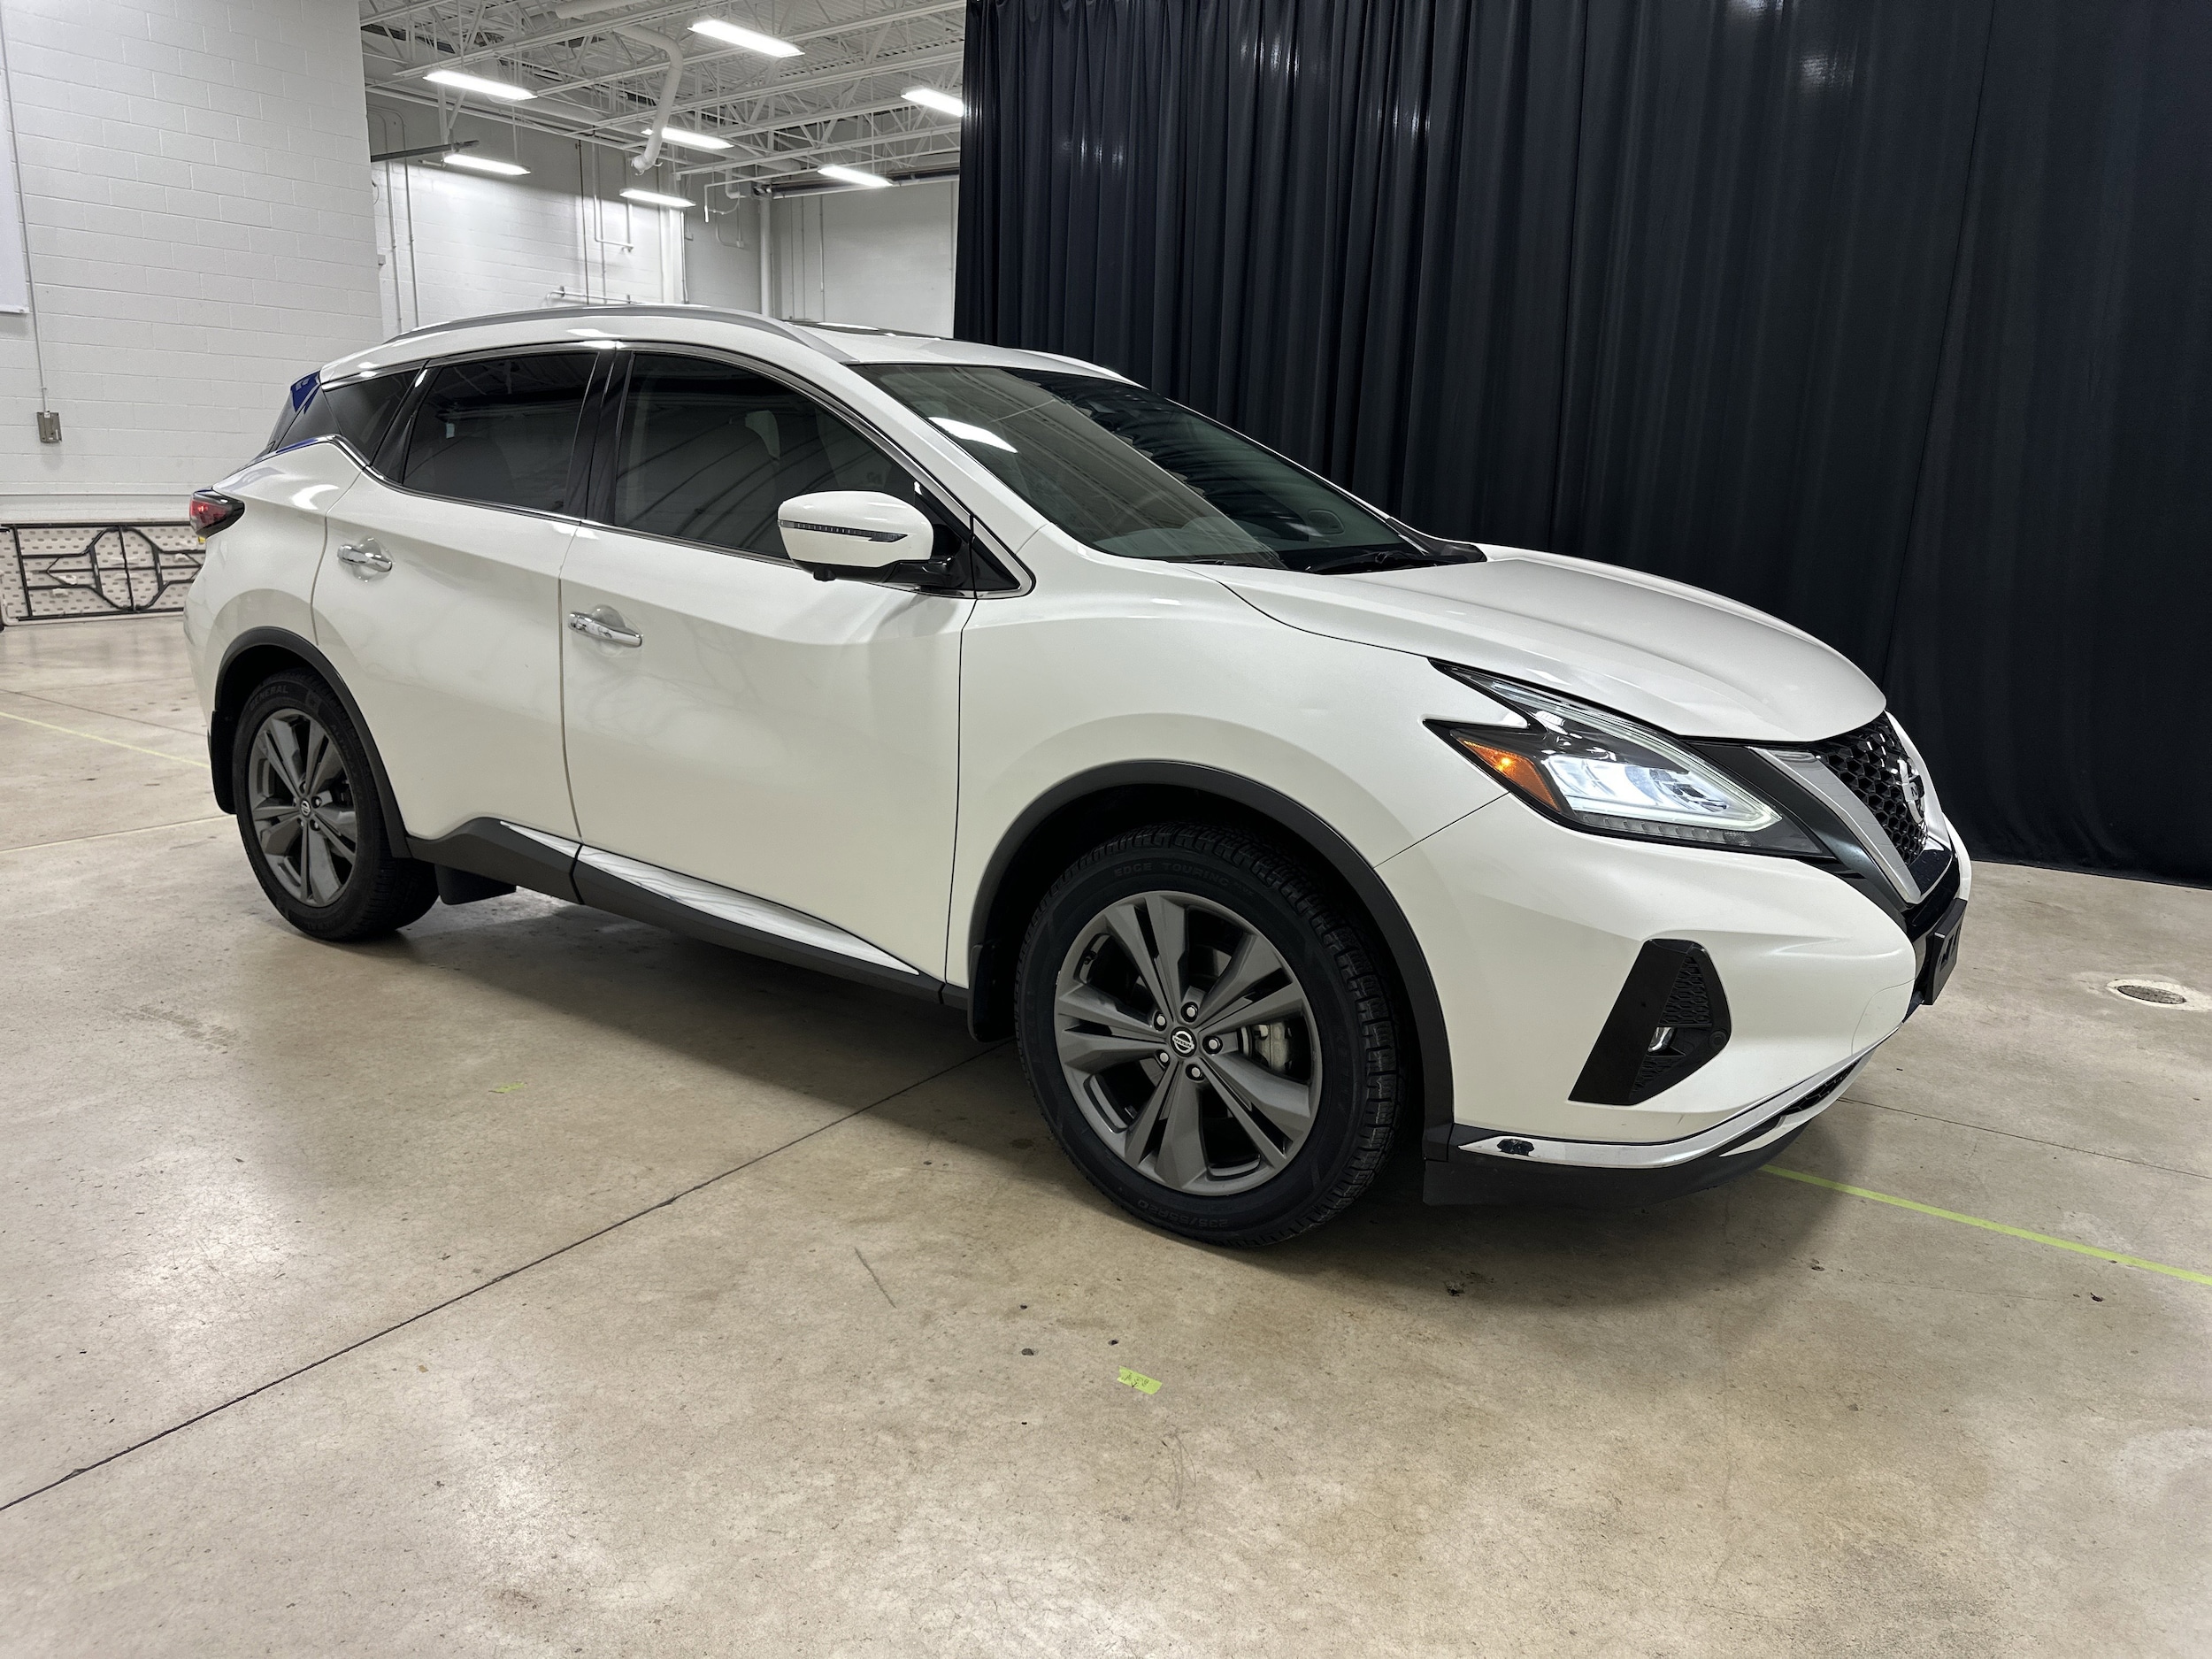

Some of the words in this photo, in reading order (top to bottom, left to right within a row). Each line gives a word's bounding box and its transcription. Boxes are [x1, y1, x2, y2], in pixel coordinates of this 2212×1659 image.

[250, 685, 289, 710] GENERAL
[1113, 862, 1153, 878] EDGE
[1162, 862, 1231, 887] TOURING
[1137, 1199, 1229, 1228] 235/55R20
